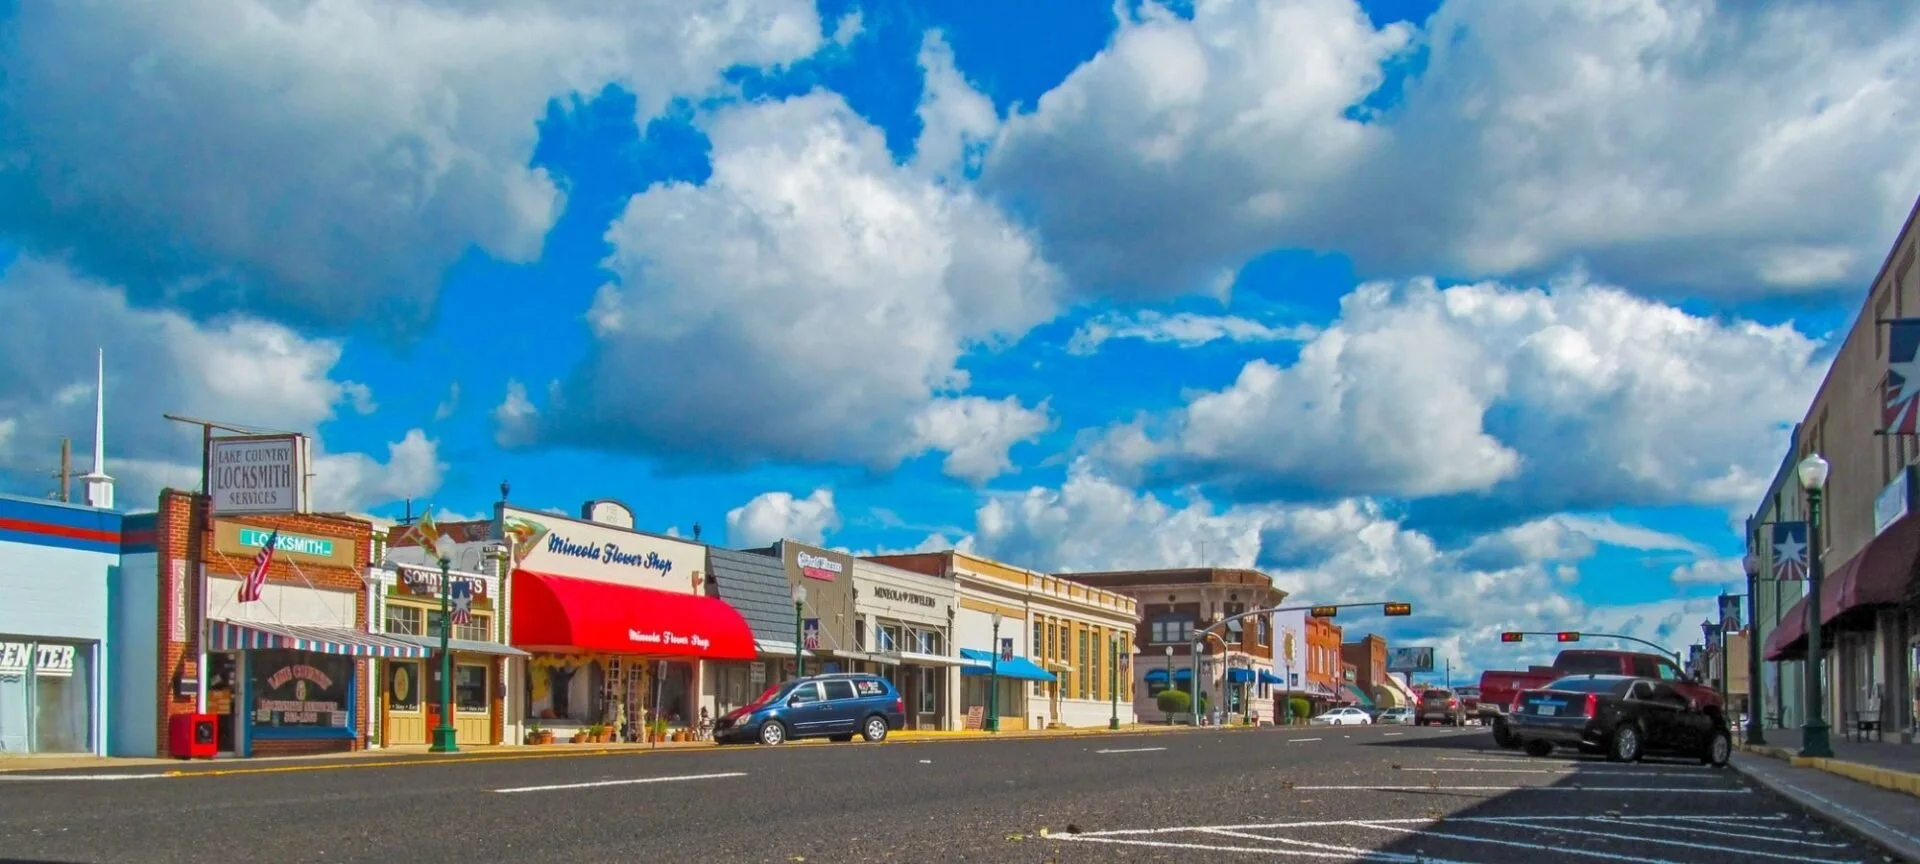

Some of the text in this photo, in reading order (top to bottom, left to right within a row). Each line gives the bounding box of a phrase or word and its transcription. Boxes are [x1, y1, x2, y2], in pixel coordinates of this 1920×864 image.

[218, 447, 290, 464] LAKE COUNTRY
[217, 464, 290, 489] LOCKSMITH
[229, 491, 277, 505] SERVICES
[250, 531, 324, 556] LOKSMITH
[547, 533, 673, 577] Mineola Flower Shop
[874, 586, 936, 608] MINEOLA JEWELERS
[628, 628, 711, 651] Mineola Flower Shop
